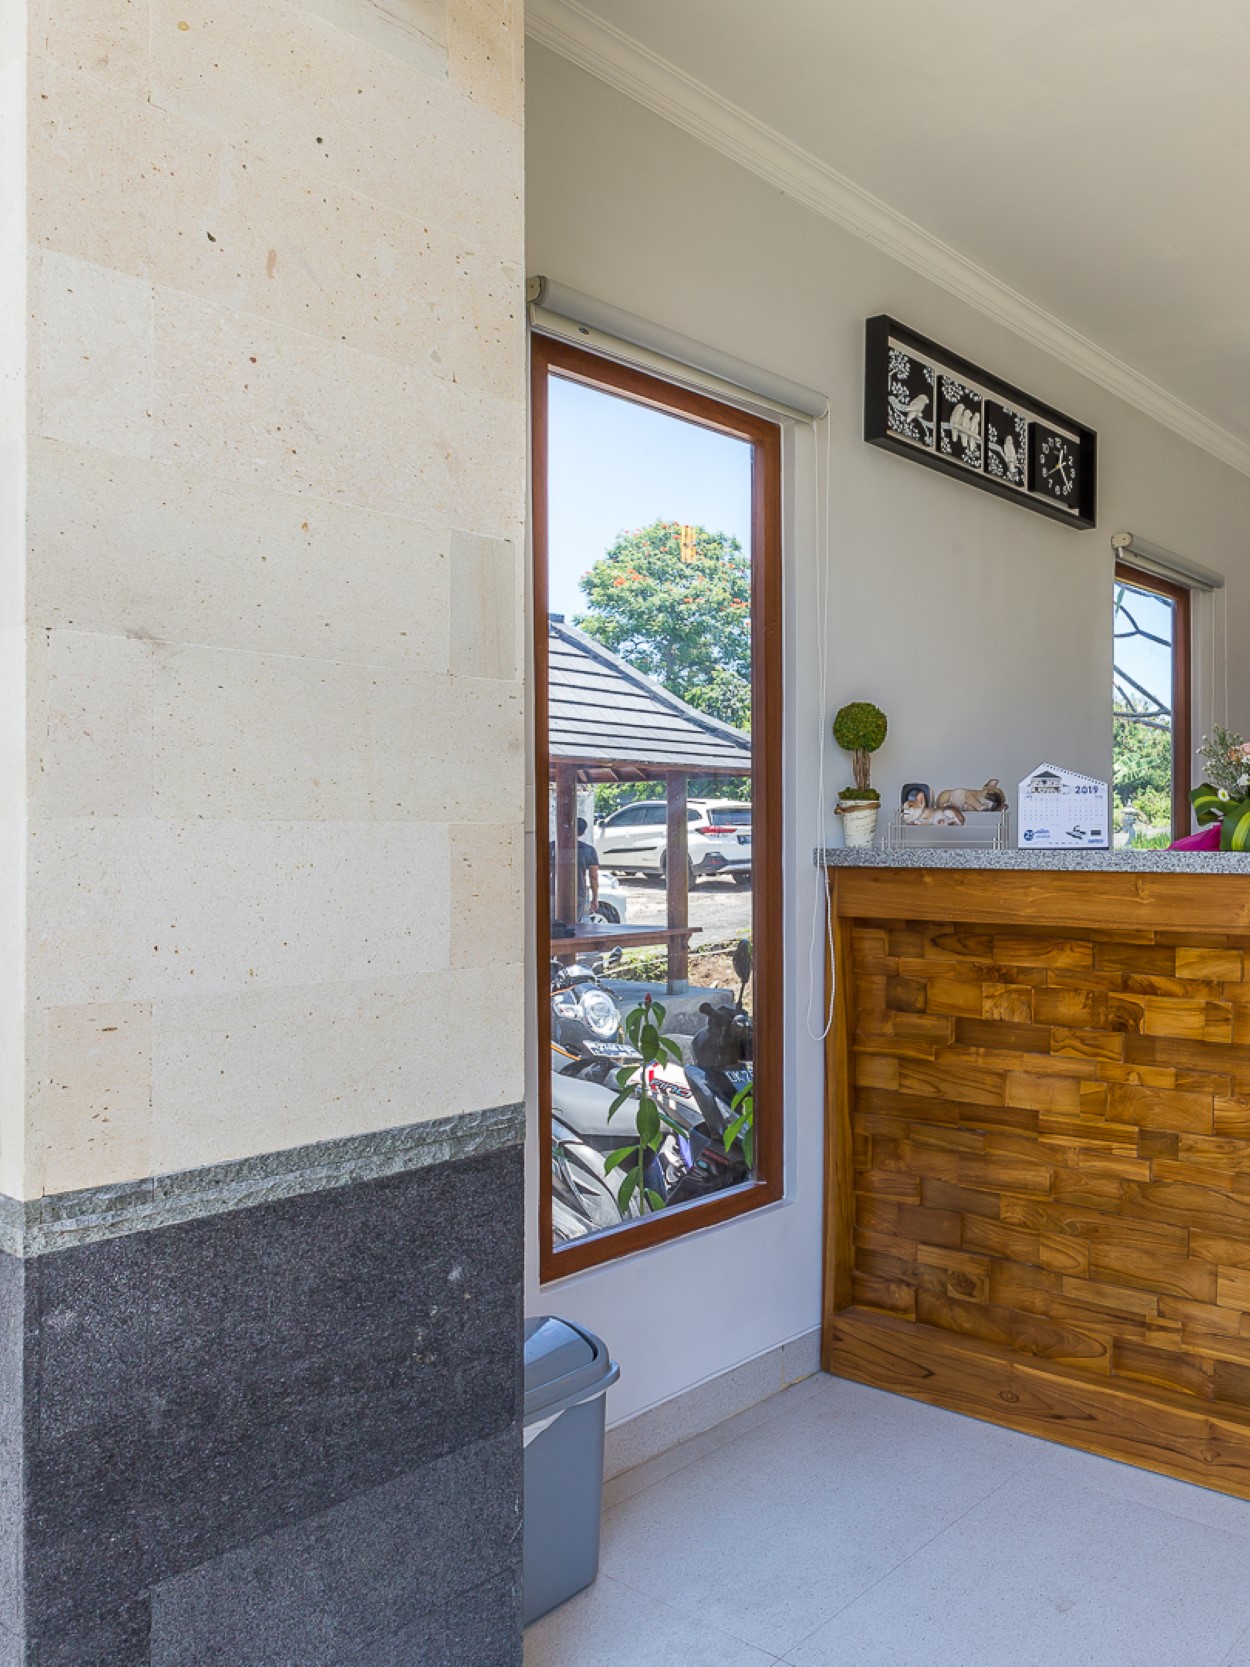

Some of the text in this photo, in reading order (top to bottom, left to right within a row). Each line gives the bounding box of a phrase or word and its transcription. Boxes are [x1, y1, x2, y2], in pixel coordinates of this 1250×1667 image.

[1055, 437, 1062, 448] 12
[1041, 443, 1050, 454] 10
[1040, 454, 1046, 464] 9
[1068, 455, 1074, 466] 2
[1070, 468, 1076, 479] 3
[1048, 479, 1053, 488] 7
[1074, 785, 1099, 795] 2019
